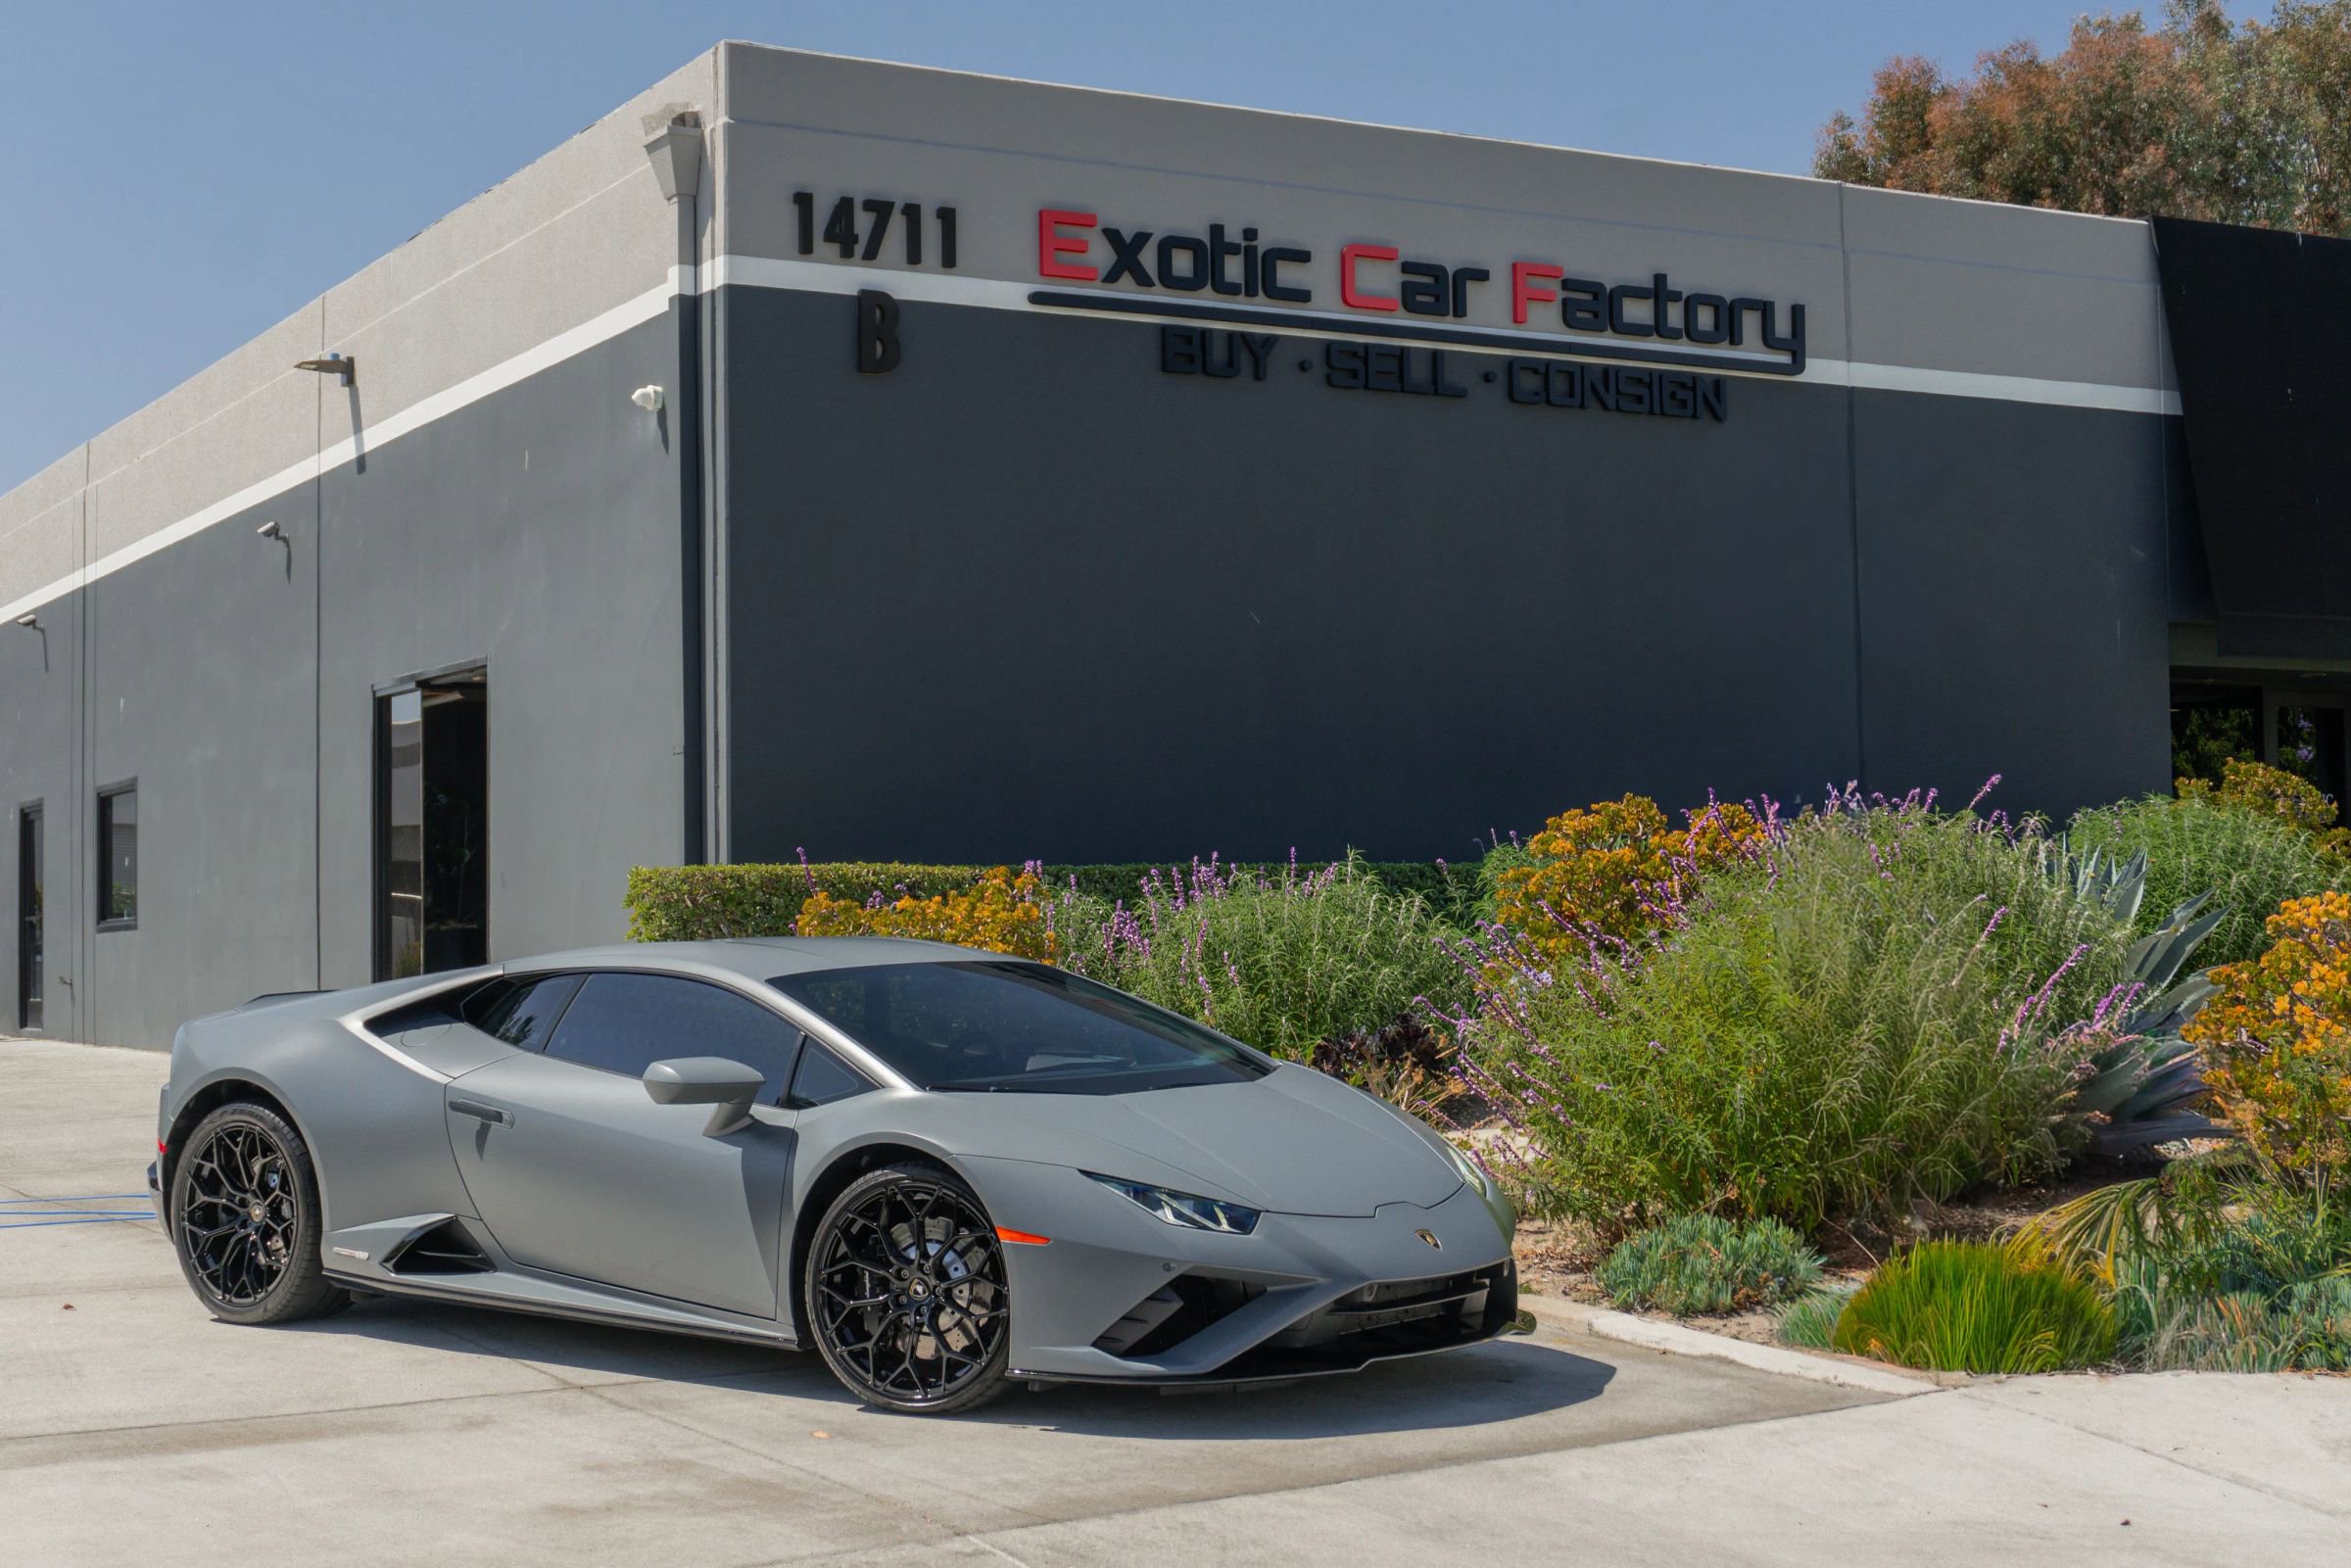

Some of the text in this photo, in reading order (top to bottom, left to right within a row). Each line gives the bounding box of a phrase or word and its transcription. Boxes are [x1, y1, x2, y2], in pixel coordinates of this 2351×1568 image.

[792, 191, 957, 268] 14711
[856, 289, 900, 374] B
[1039, 209, 1805, 375] Exotic Car Factory
[1161, 325, 1728, 422] BUY SELL CONSIGN
